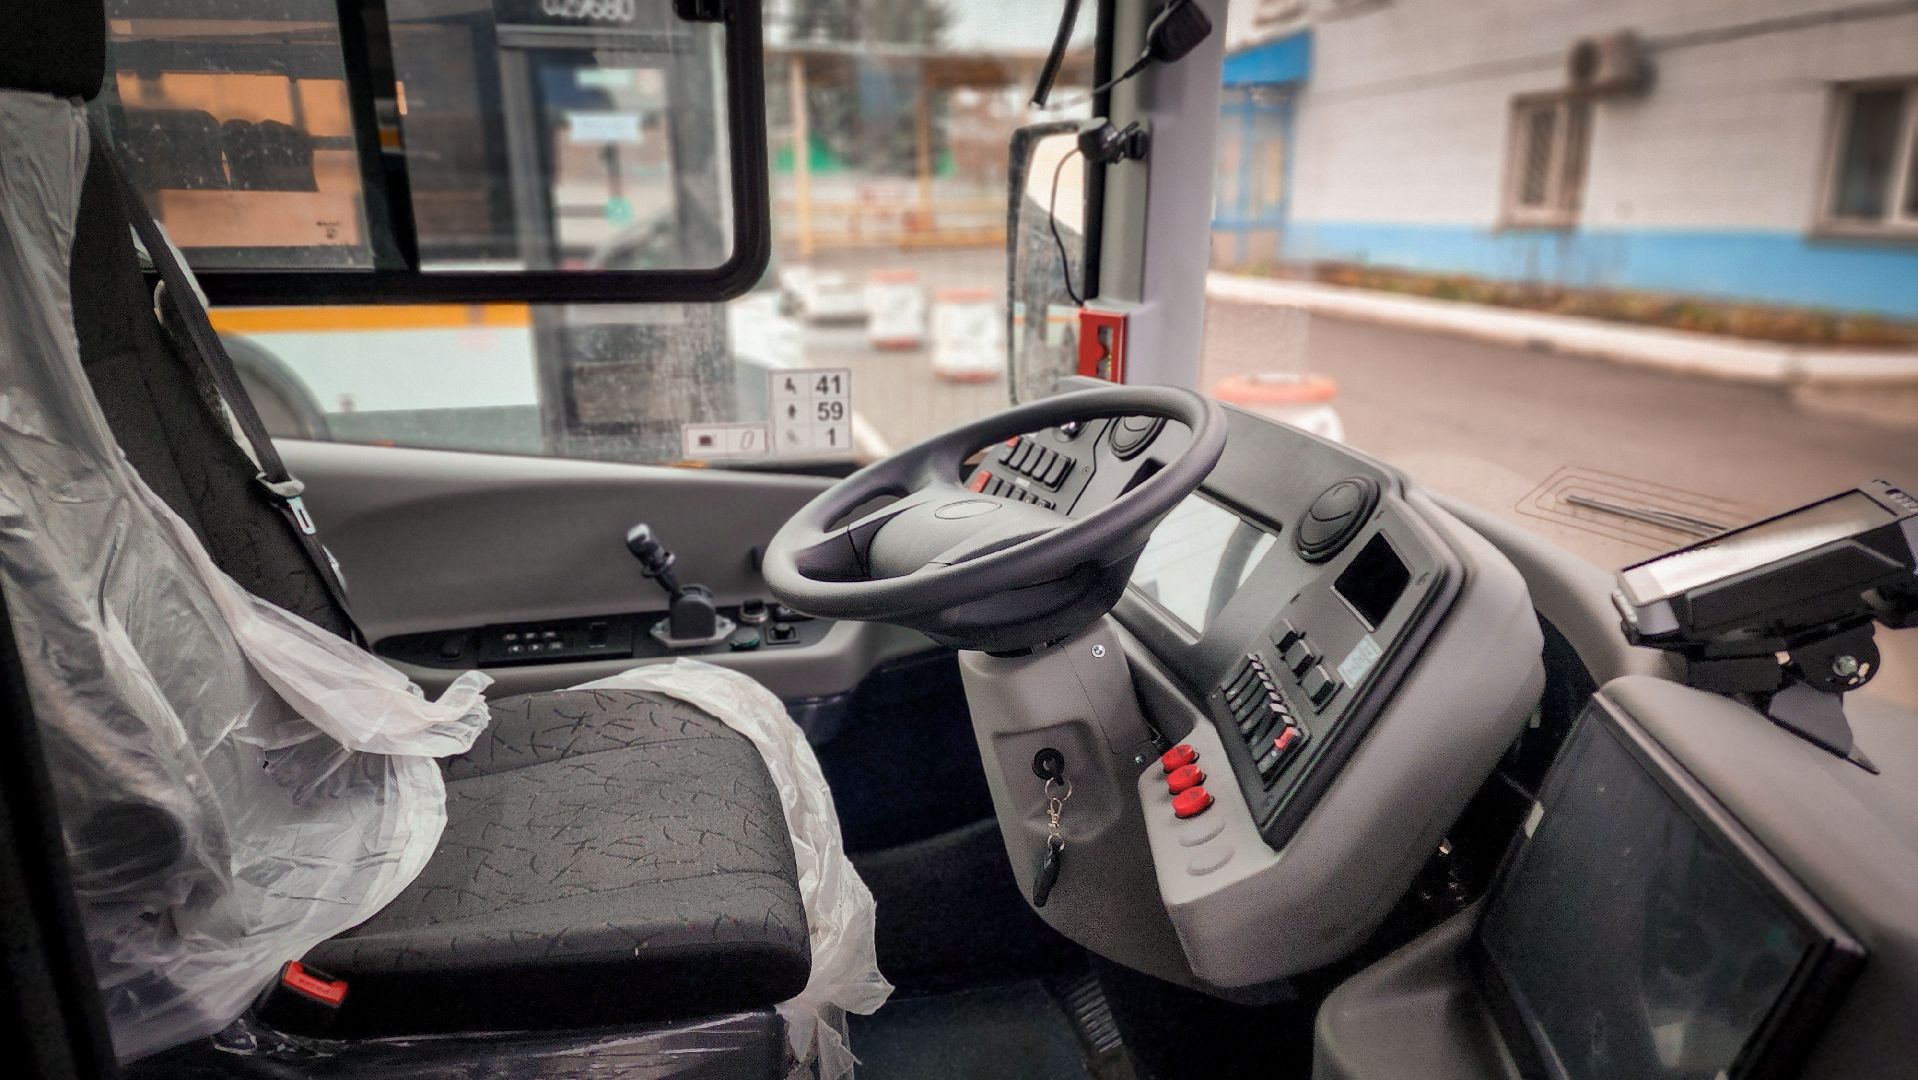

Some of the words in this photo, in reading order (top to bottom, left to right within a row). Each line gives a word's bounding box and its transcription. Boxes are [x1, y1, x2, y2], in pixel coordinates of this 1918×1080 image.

[815, 374, 841, 394] 41
[817, 401, 844, 421] 59
[825, 427, 836, 446] 1
